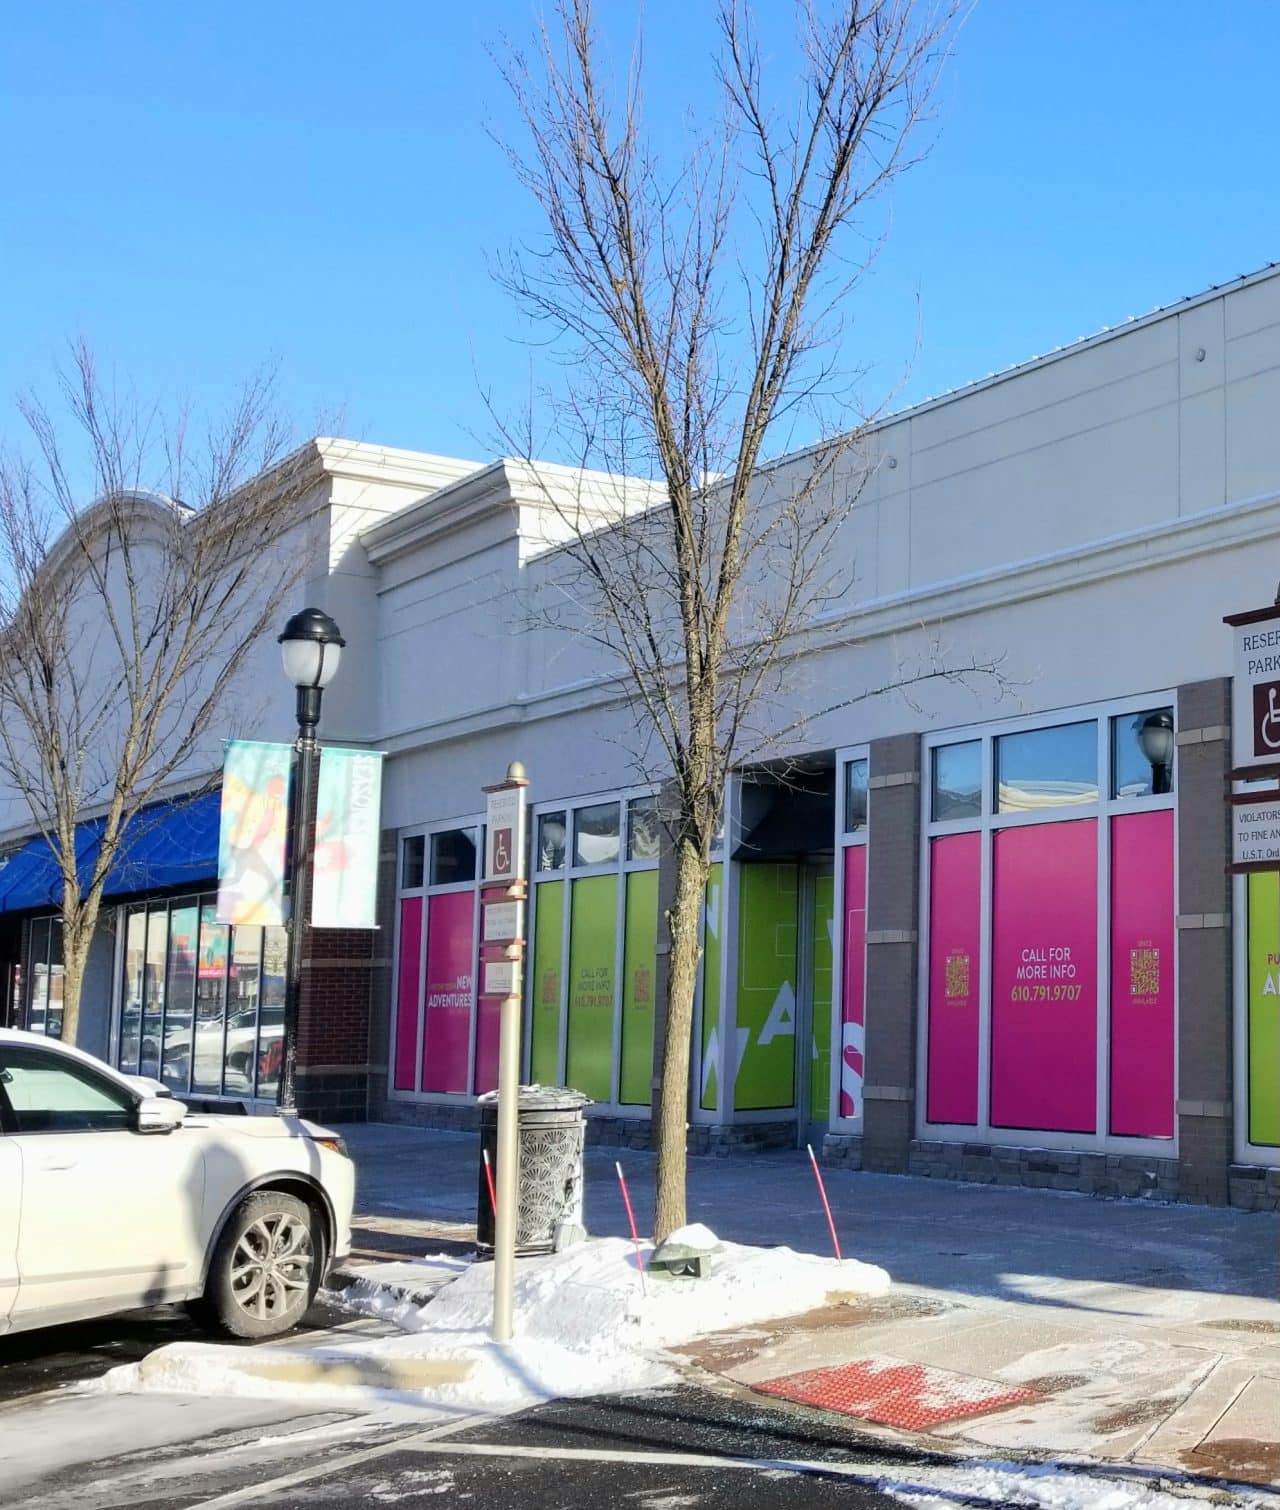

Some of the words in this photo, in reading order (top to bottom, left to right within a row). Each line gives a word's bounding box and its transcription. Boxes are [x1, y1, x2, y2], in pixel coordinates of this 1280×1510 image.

[1238, 832, 1249, 841] TO
[1251, 830, 1268, 840] FINE
[1021, 948, 1047, 962] CALL
[1049, 947, 1071, 961] FOR
[1016, 965, 1047, 979] MORE
[1050, 964, 1076, 979] INFO
[428, 993, 472, 1008] ADVENTURES
[1011, 985, 1082, 1001] 610.791.9707
